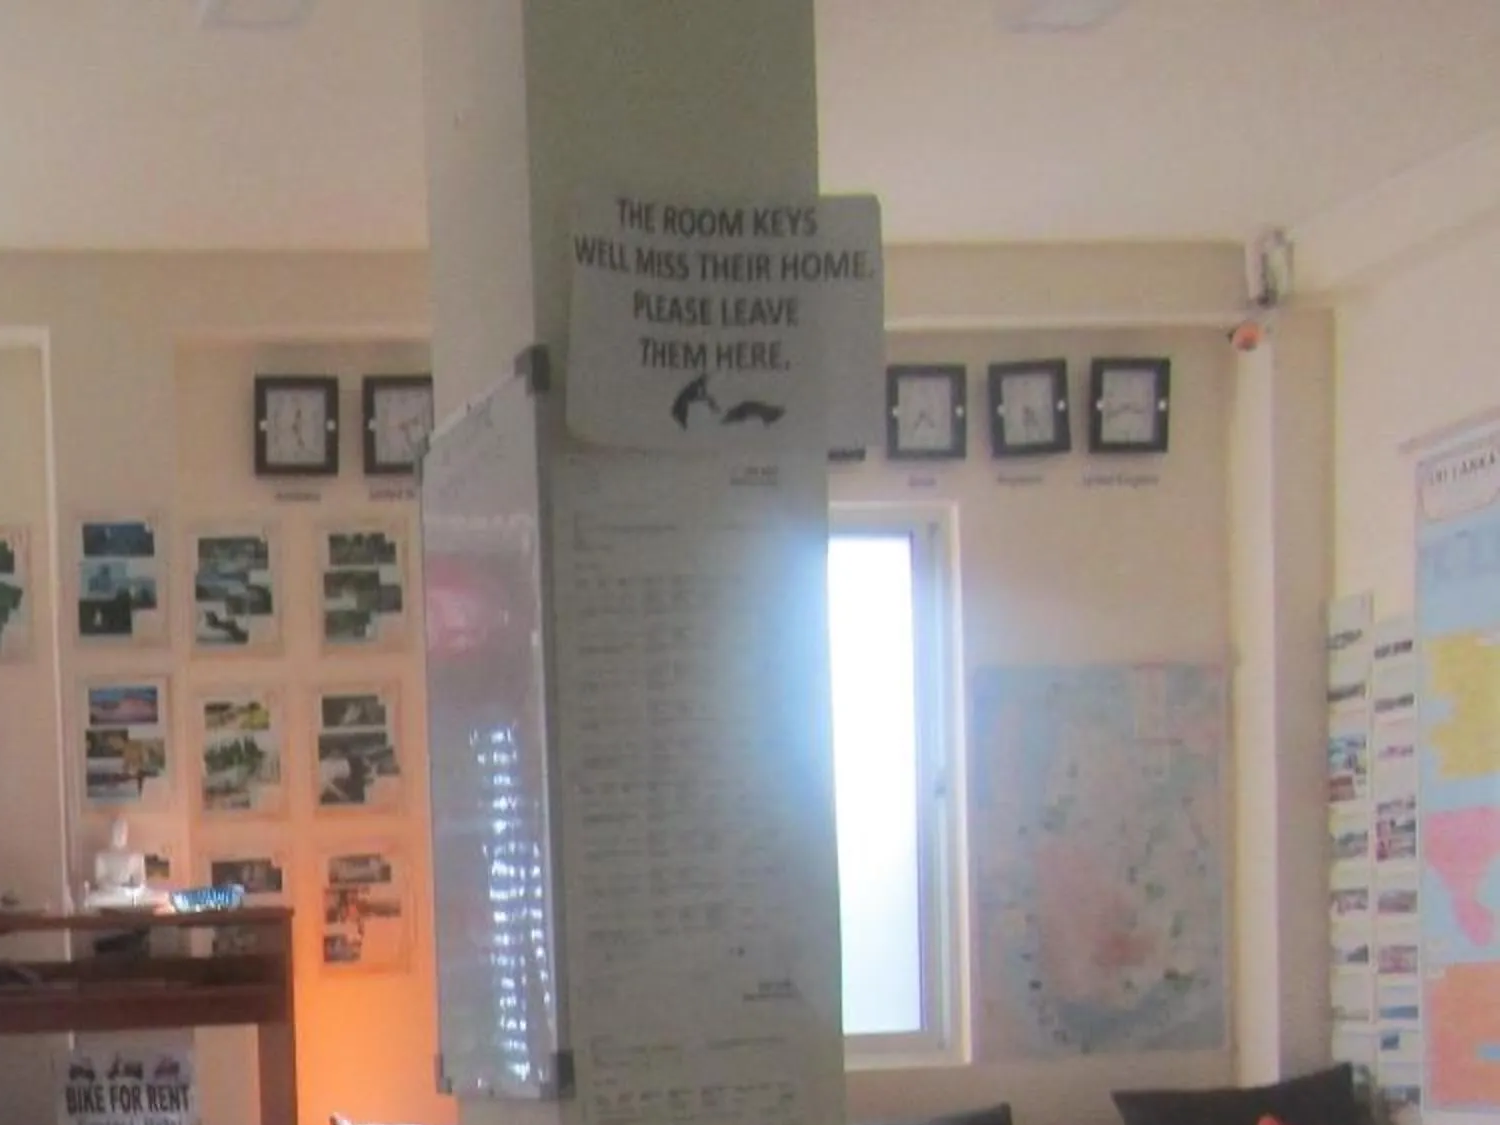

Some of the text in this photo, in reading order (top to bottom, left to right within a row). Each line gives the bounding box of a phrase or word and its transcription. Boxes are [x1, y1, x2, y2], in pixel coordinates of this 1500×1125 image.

[616, 198, 818, 239] THE ROOM KEYS
[573, 235, 630, 274] WELL
[633, 247, 690, 281] MISS
[699, 250, 773, 282] THEIR
[633, 289, 800, 328] PLEASE LEAVE
[639, 336, 707, 371] THEM
[65, 1083, 190, 1115] BIKE FOR RENT
